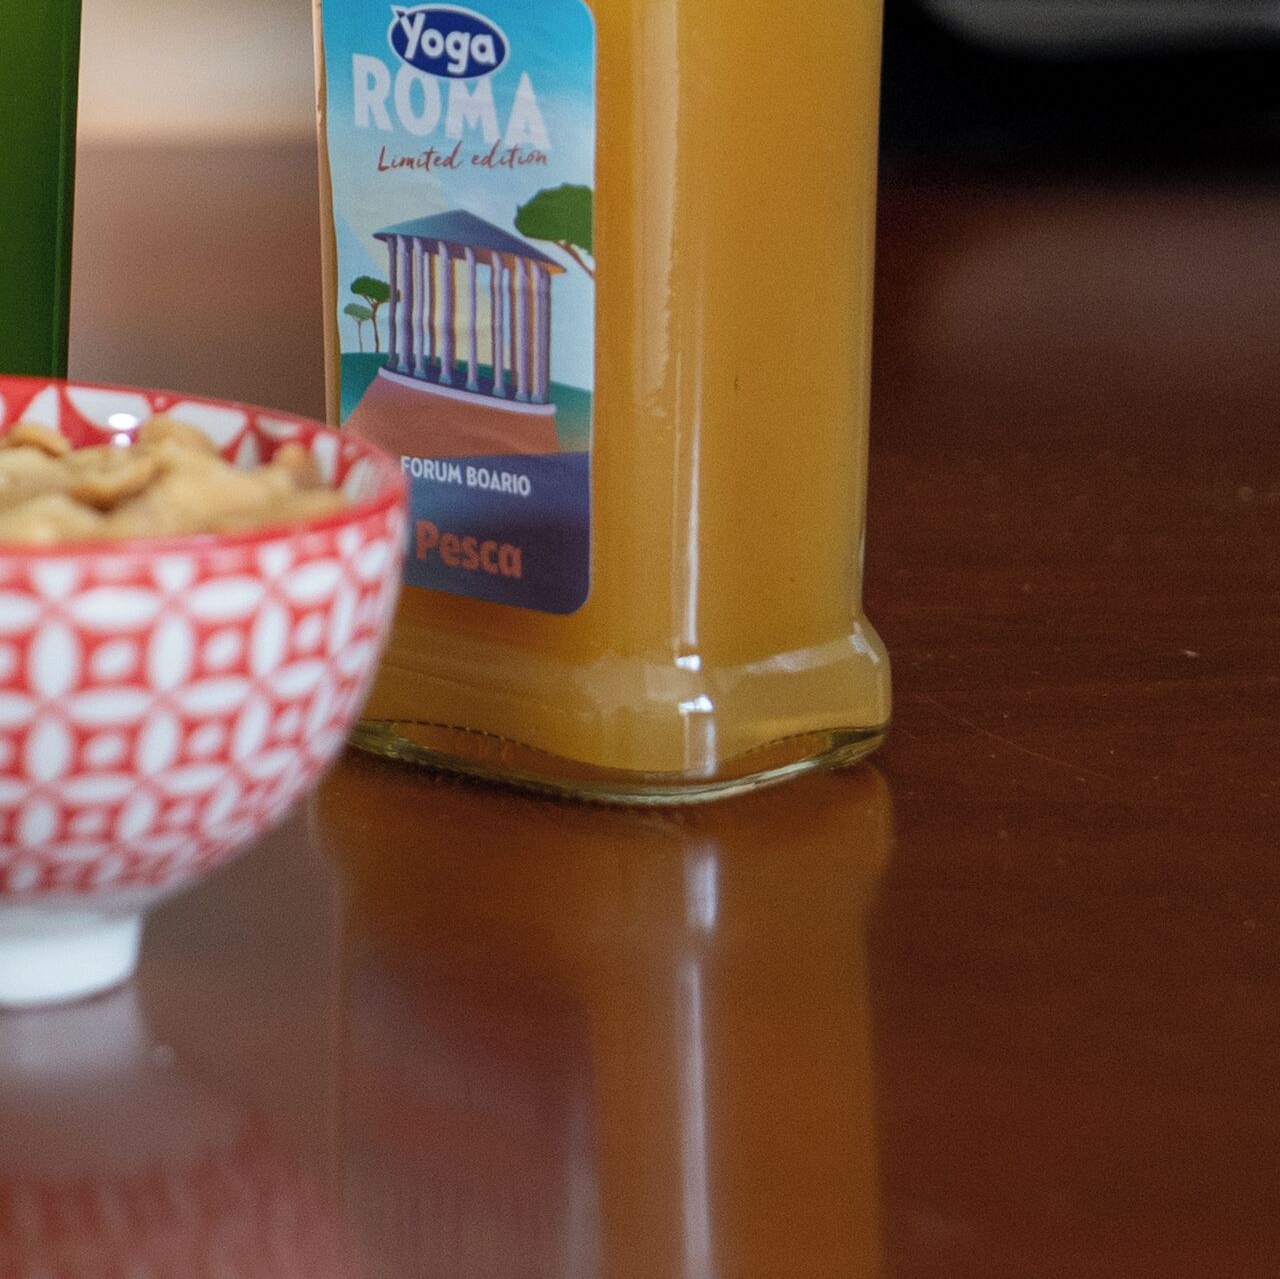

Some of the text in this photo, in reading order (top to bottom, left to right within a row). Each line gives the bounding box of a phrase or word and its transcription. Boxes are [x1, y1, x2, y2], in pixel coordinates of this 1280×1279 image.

[399, 10, 498, 76] Yoga
[351, 52, 552, 150] ROMA
[376, 139, 549, 173] Limited edition
[400, 454, 532, 497] FORUM BOARIO
[415, 519, 523, 579] Pesca
